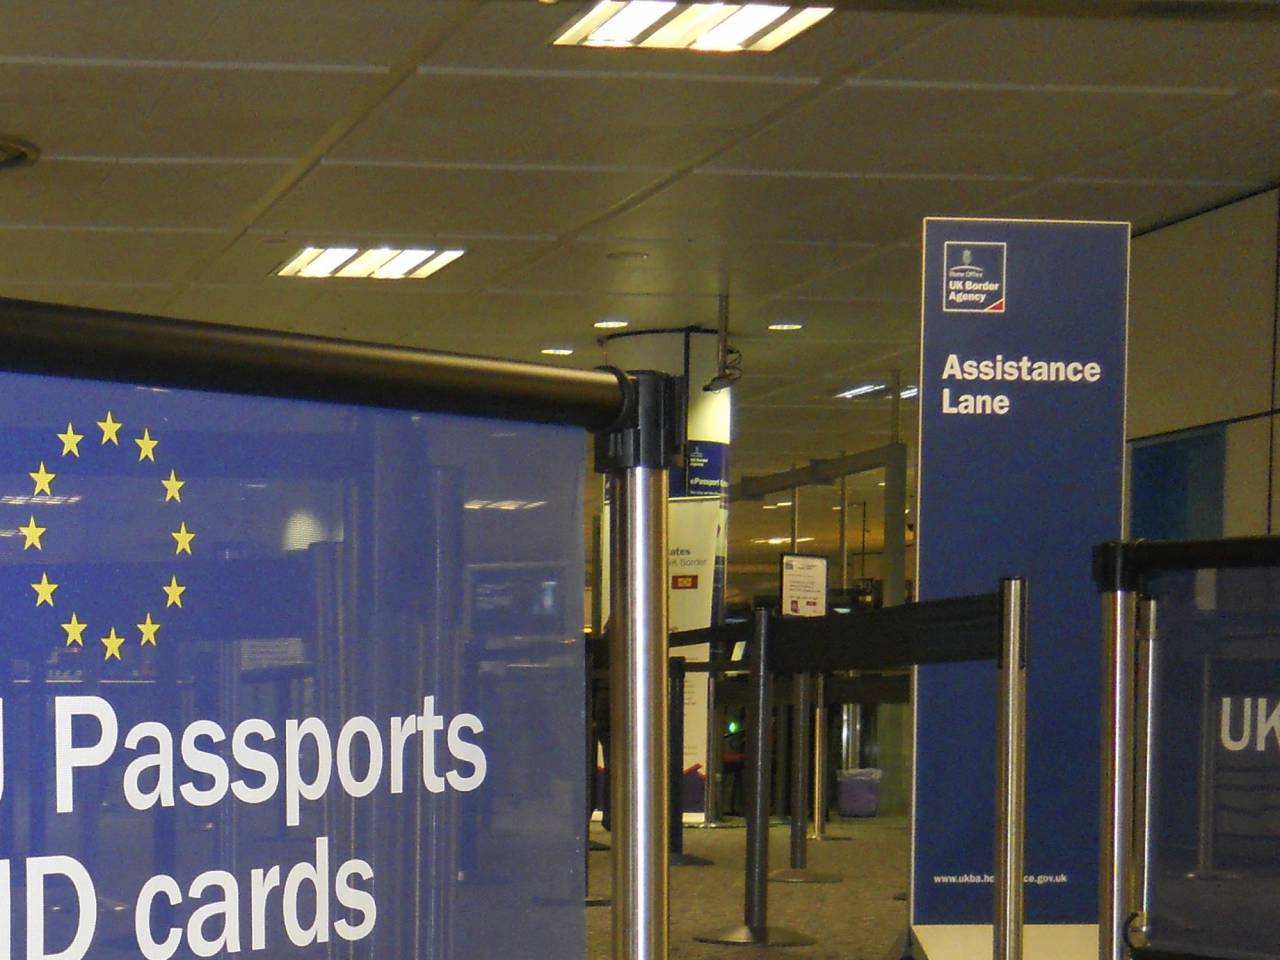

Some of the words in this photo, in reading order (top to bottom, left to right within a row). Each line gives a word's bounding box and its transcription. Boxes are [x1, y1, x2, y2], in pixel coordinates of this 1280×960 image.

[948, 280, 963, 290] UK
[965, 280, 999, 291] Border
[948, 291, 986, 303] Agency
[942, 354, 1102, 383] Assistance
[942, 388, 1011, 415] Lane
[55, 696, 486, 826] Passports
